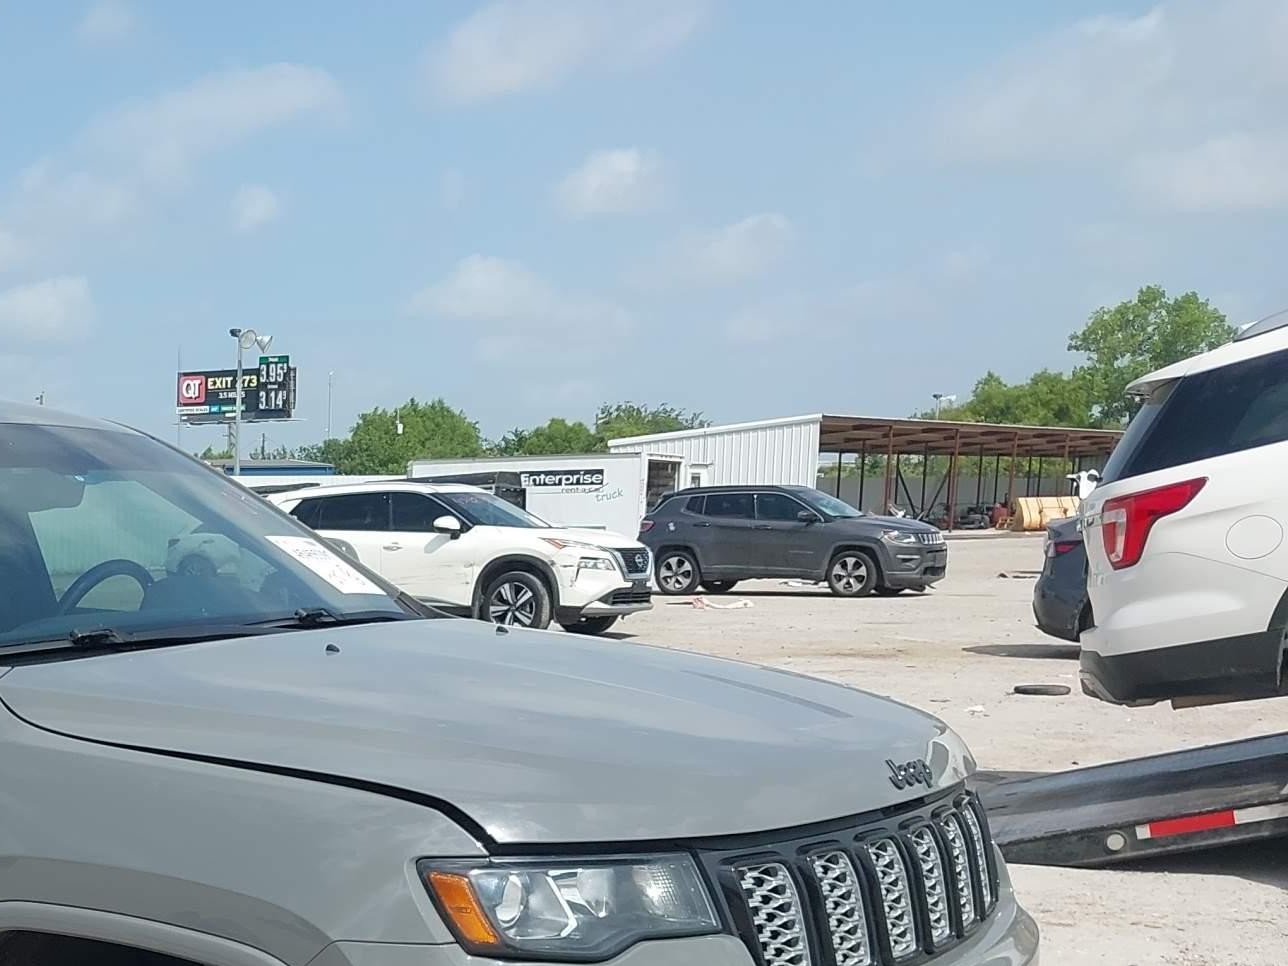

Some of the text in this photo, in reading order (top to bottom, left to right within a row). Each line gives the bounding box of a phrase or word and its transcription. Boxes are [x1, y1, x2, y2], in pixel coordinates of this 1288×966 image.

[182, 380, 201, 399] QT
[207, 377, 233, 389] EXIT
[520, 471, 603, 486] Enterprise
[595, 488, 624, 502] truck
[885, 759, 933, 790] Jeep
